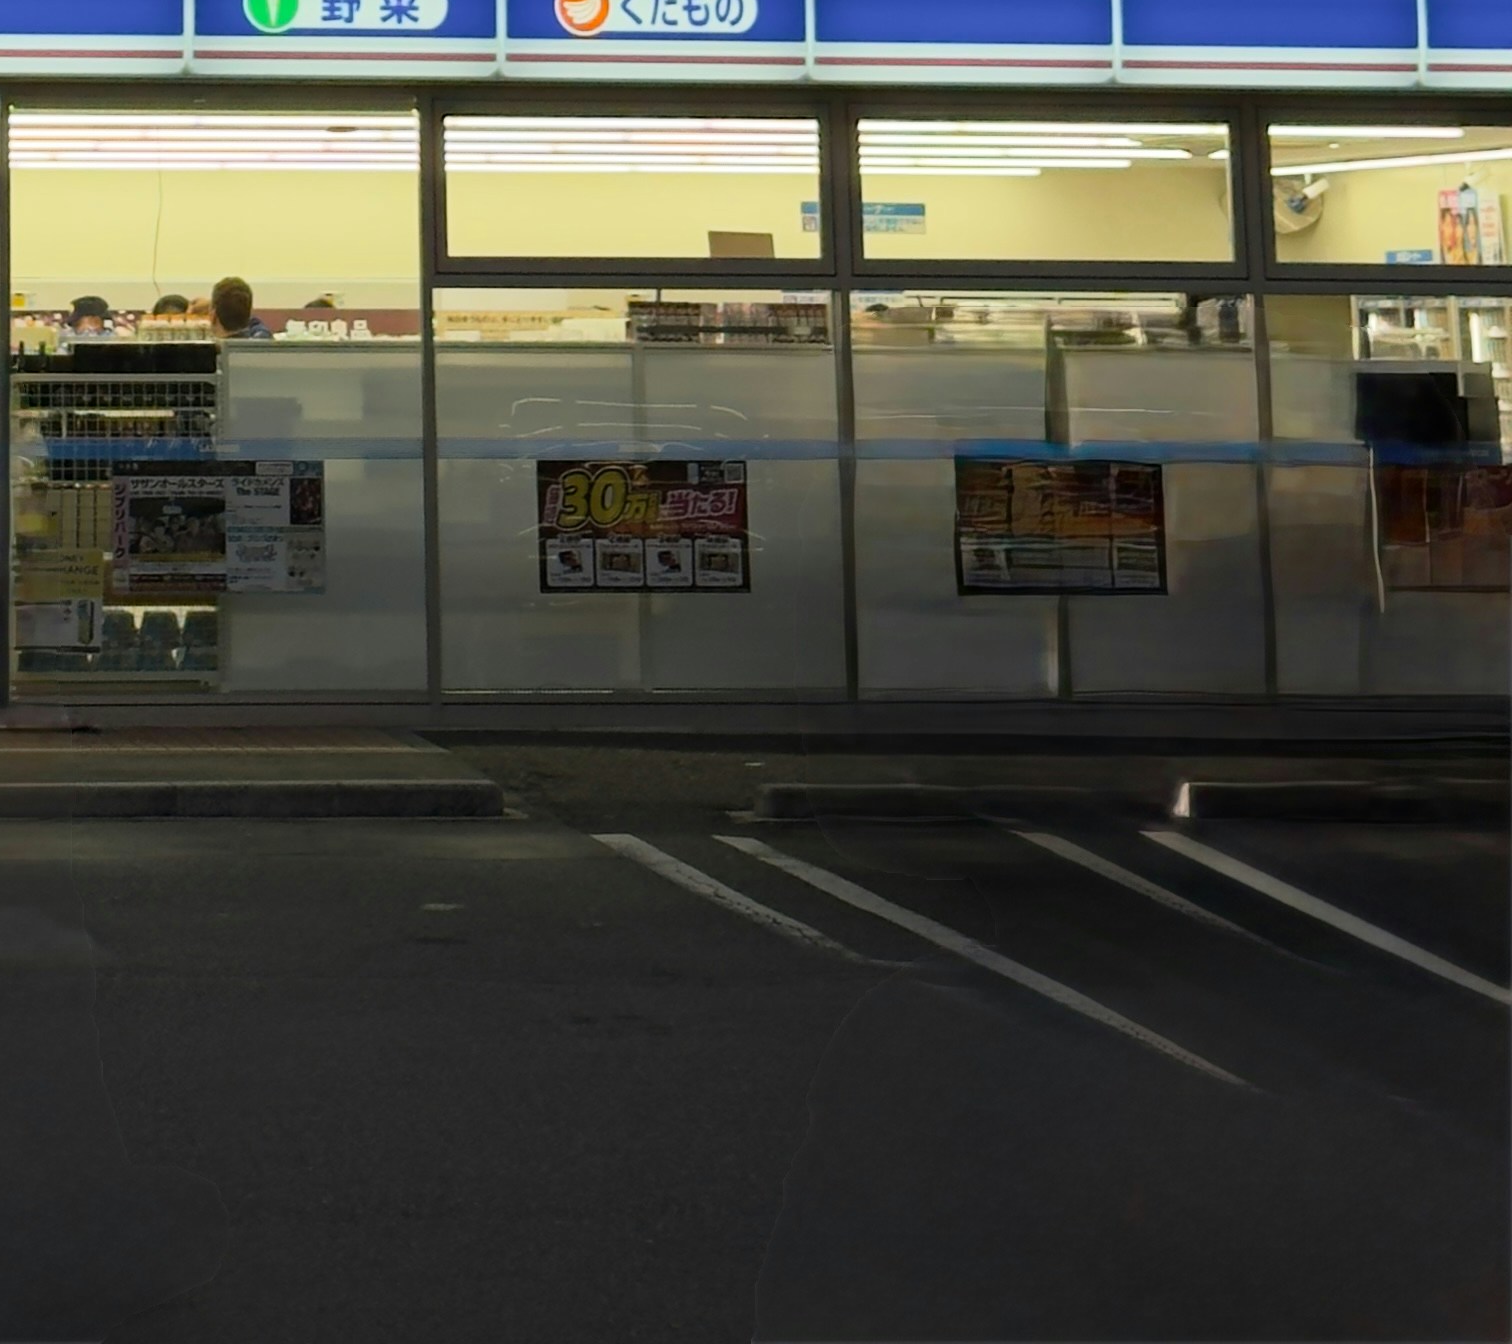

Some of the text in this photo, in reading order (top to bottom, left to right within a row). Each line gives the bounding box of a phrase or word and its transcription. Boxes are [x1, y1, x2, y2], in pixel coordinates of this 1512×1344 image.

[129, 478, 225, 490] サザンオールスターズ
